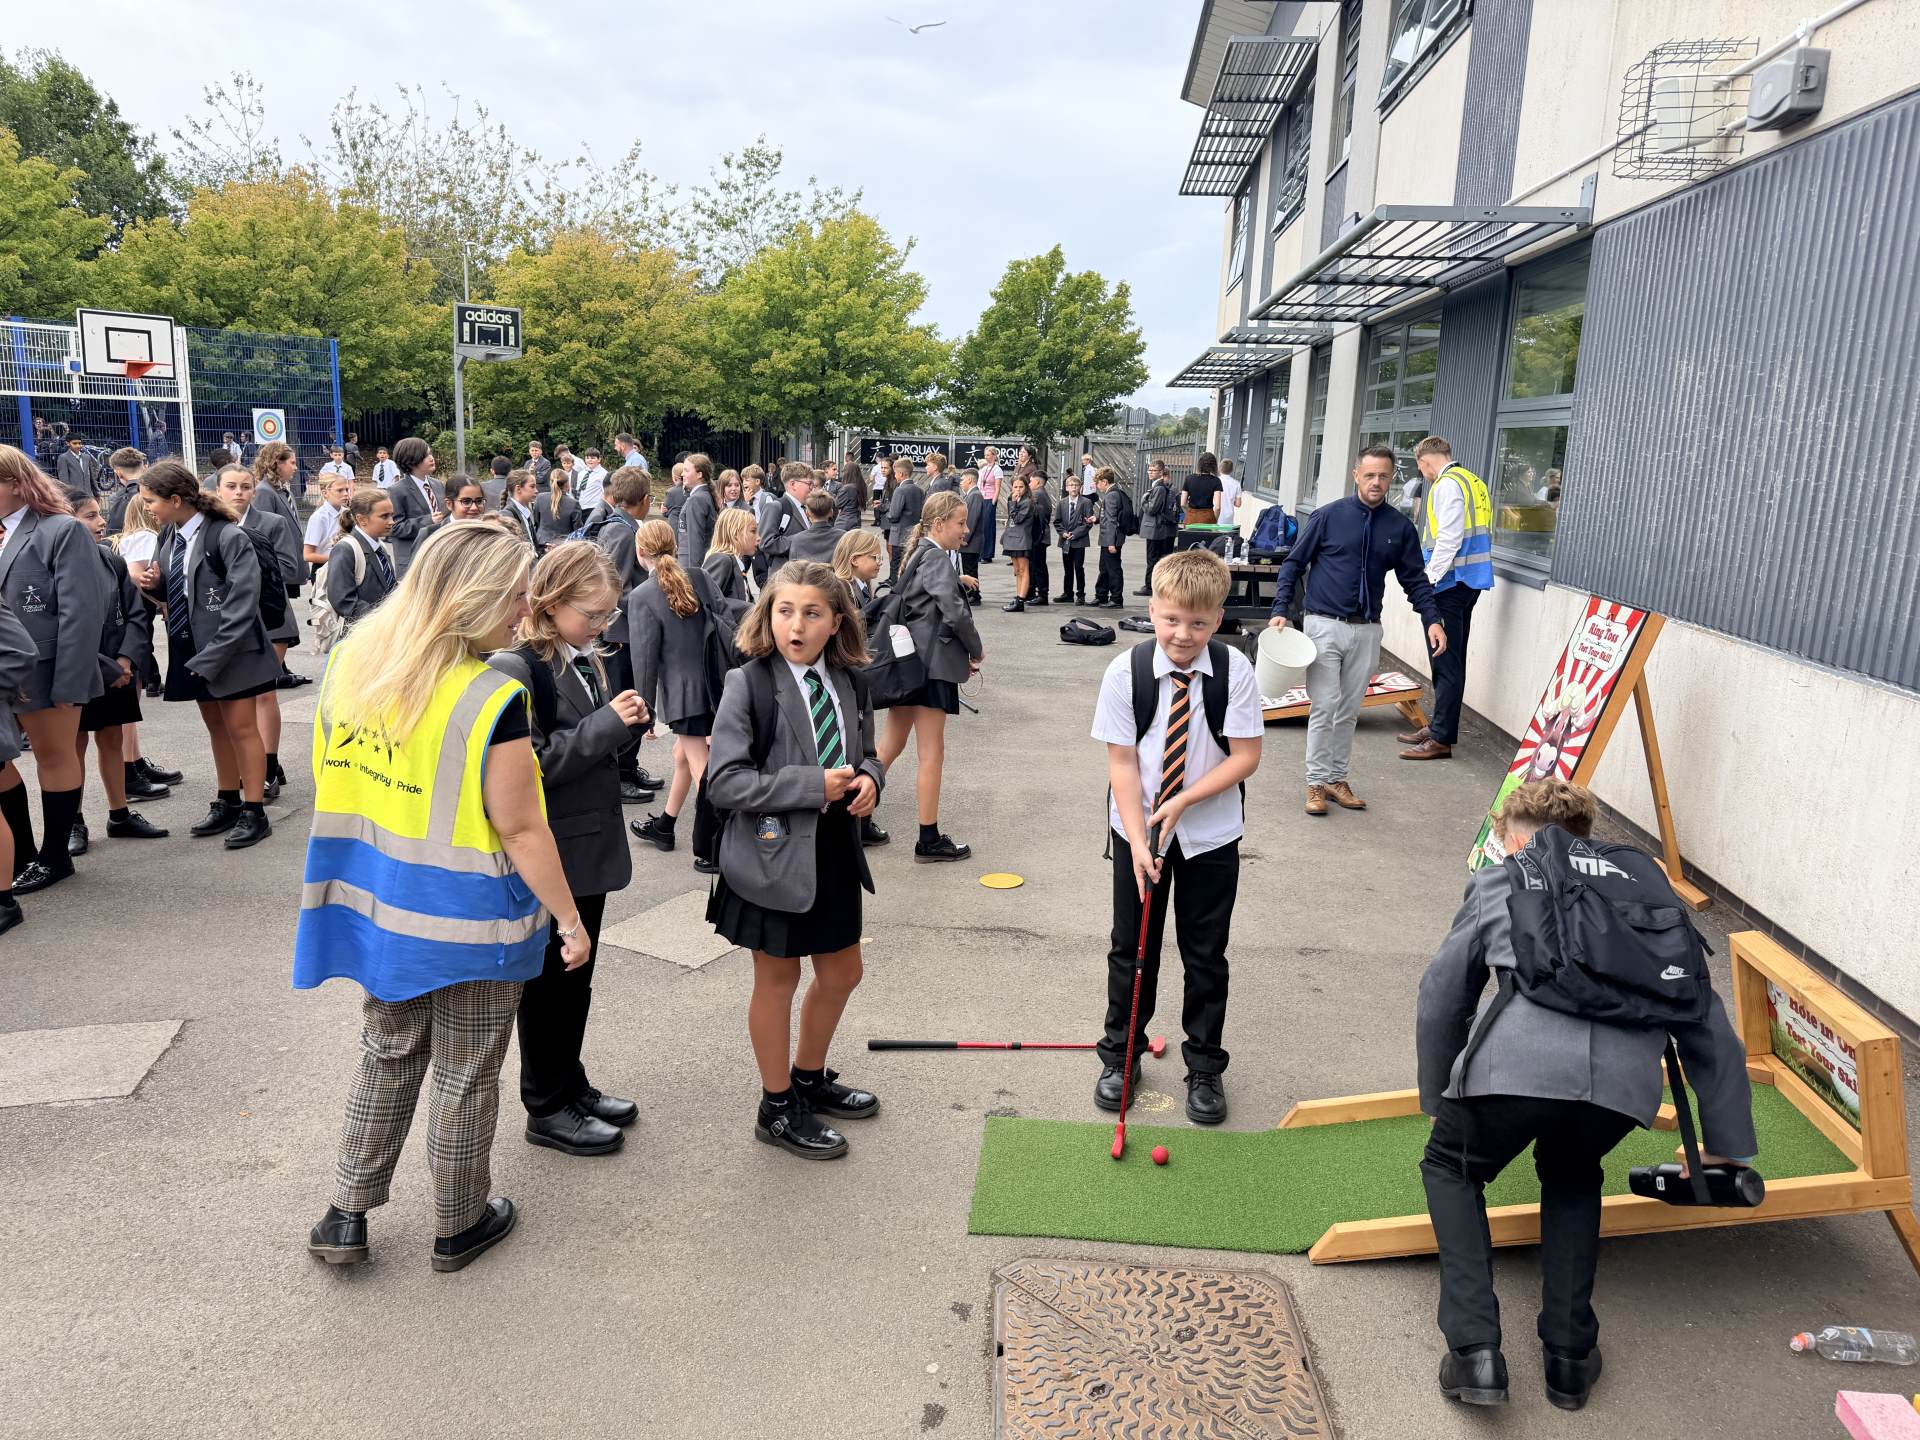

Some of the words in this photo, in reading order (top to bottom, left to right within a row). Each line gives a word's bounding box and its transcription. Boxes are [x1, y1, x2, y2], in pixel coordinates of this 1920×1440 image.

[465, 309, 513, 324] adidas
[889, 443, 941, 456] TORQUAY
[1588, 622, 1605, 641] Ring
[1604, 628, 1619, 644] Toss
[1588, 645, 1600, 658] Your
[1599, 650, 1612, 663] Skill
[359, 762, 392, 788] Integrity
[397, 780, 423, 796] Pride
[1667, 964, 1685, 975] NIKE
[1785, 1021, 1807, 1050] Test
[1808, 1041, 1835, 1075] Your
[1837, 1065, 1859, 1096] Ski
[1836, 1036, 1857, 1062] On
